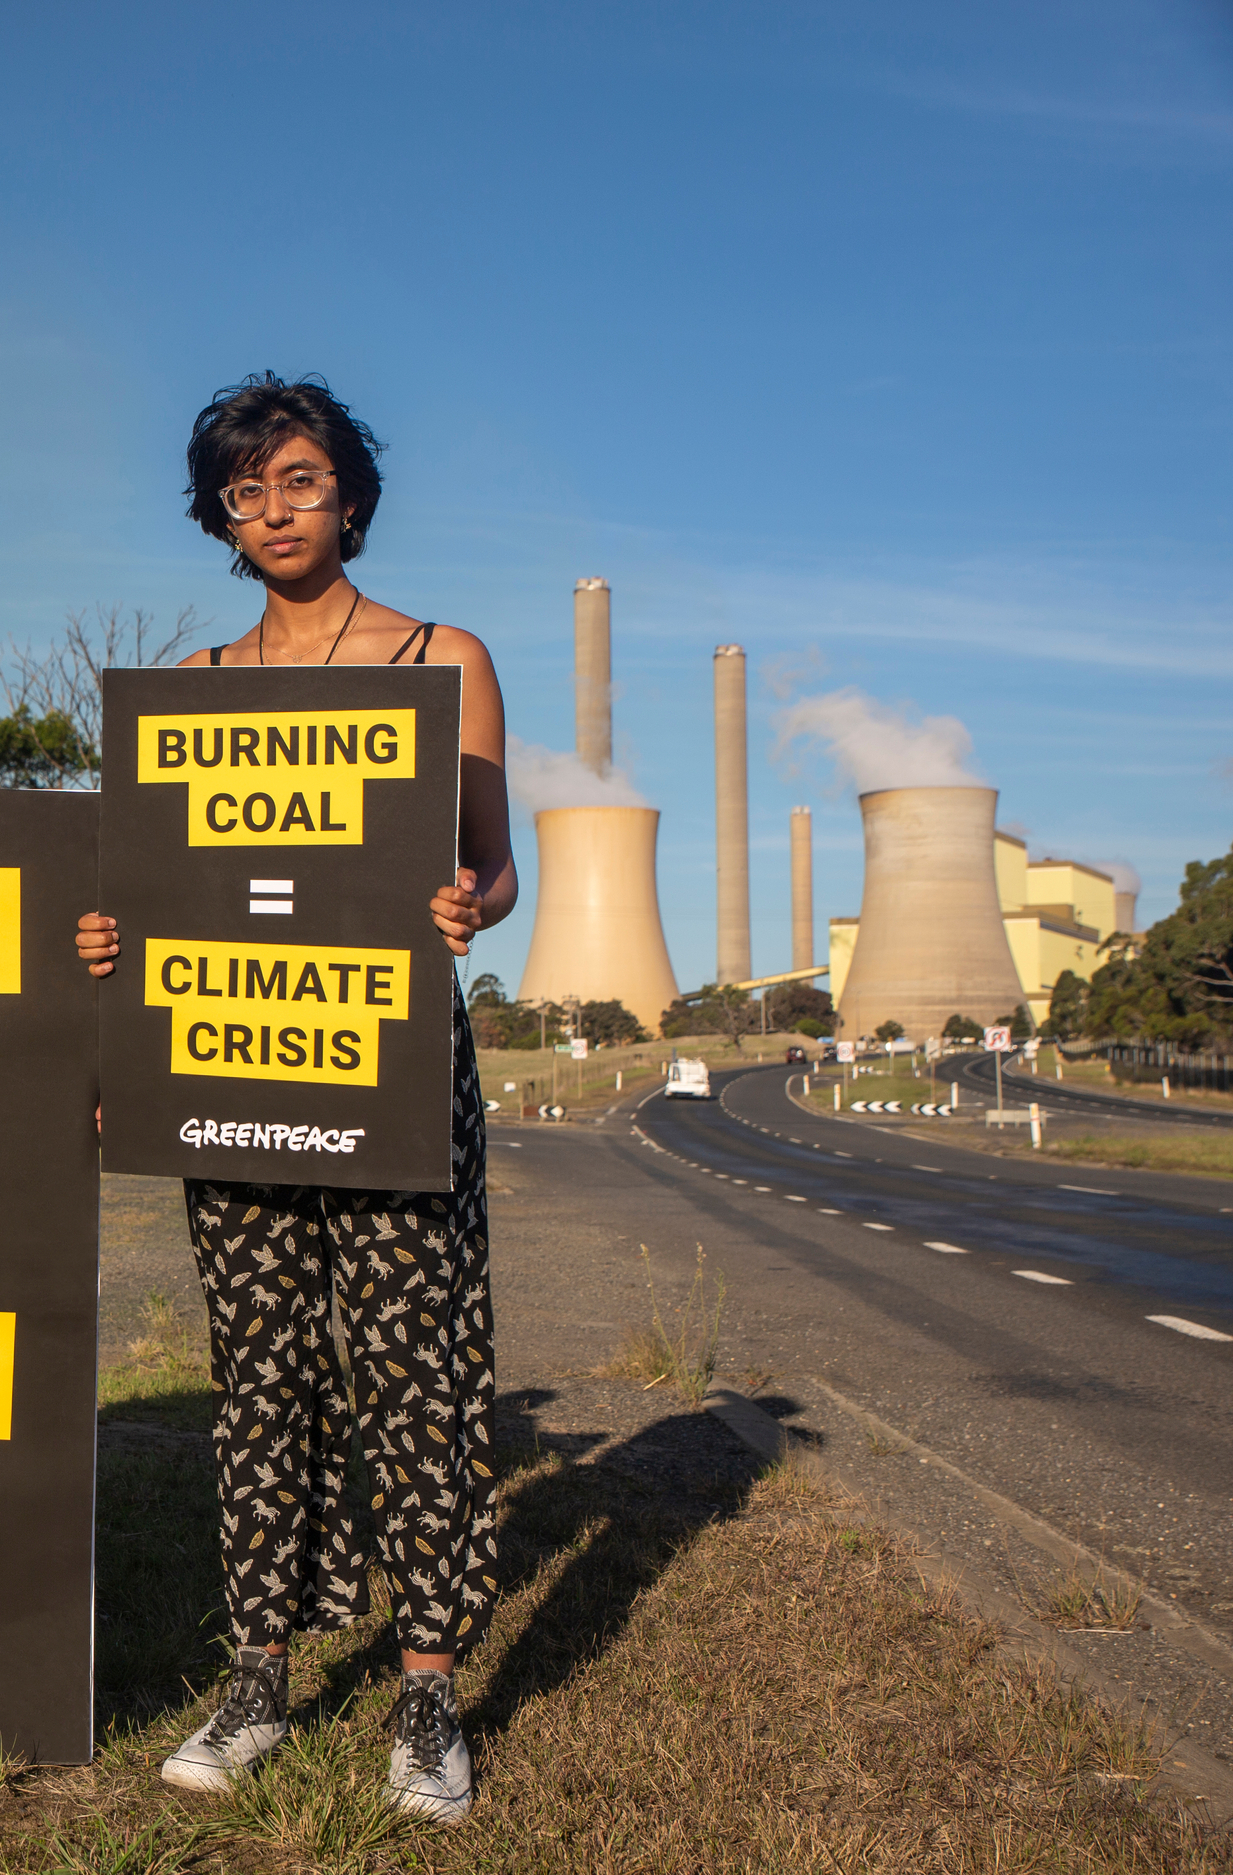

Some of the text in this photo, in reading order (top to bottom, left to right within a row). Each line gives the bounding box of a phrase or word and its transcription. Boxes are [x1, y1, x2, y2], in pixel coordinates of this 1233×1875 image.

[158, 724, 398, 769] BURNING
[206, 792, 347, 833] COAL
[160, 955, 394, 1006] CLIMATE
[187, 1022, 362, 1071] CRISIS
[179, 1118, 366, 1154] GREENPEACE
